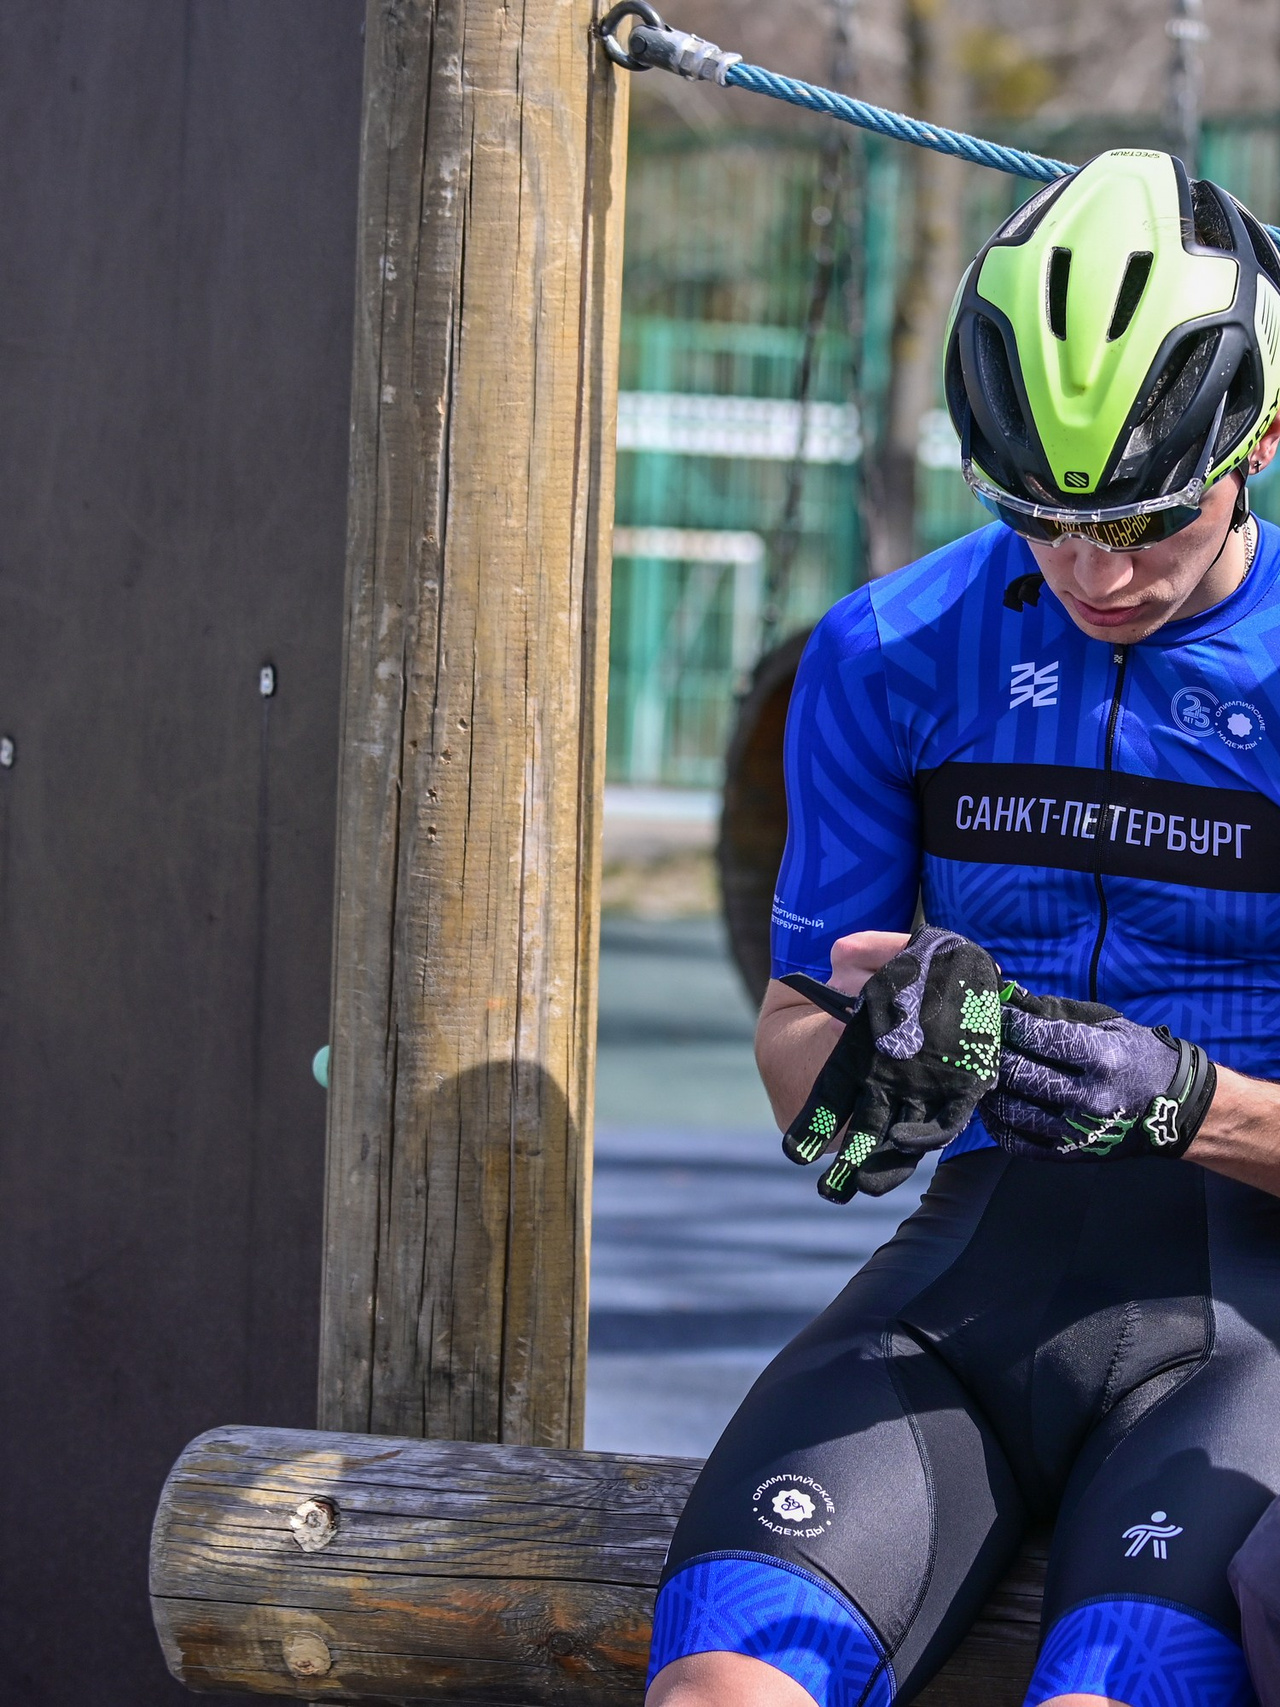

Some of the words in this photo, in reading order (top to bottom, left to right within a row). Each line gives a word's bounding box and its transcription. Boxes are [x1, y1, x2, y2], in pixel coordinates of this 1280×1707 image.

[1110, 151, 1160, 159] SPECTRUM
[1182, 694, 1211, 729] 25
[1215, 700, 1266, 732] ОЛИМПИЙСКИЕ
[1217, 730, 1258, 751] НАДЕЖДЫ
[955, 795, 1252, 859] САНКТ-ПЕТЕРБУРГ
[752, 1474, 836, 1514] ОЛИМПИЙСКИЕ
[758, 1515, 826, 1538] НАДЕЖДЫ
